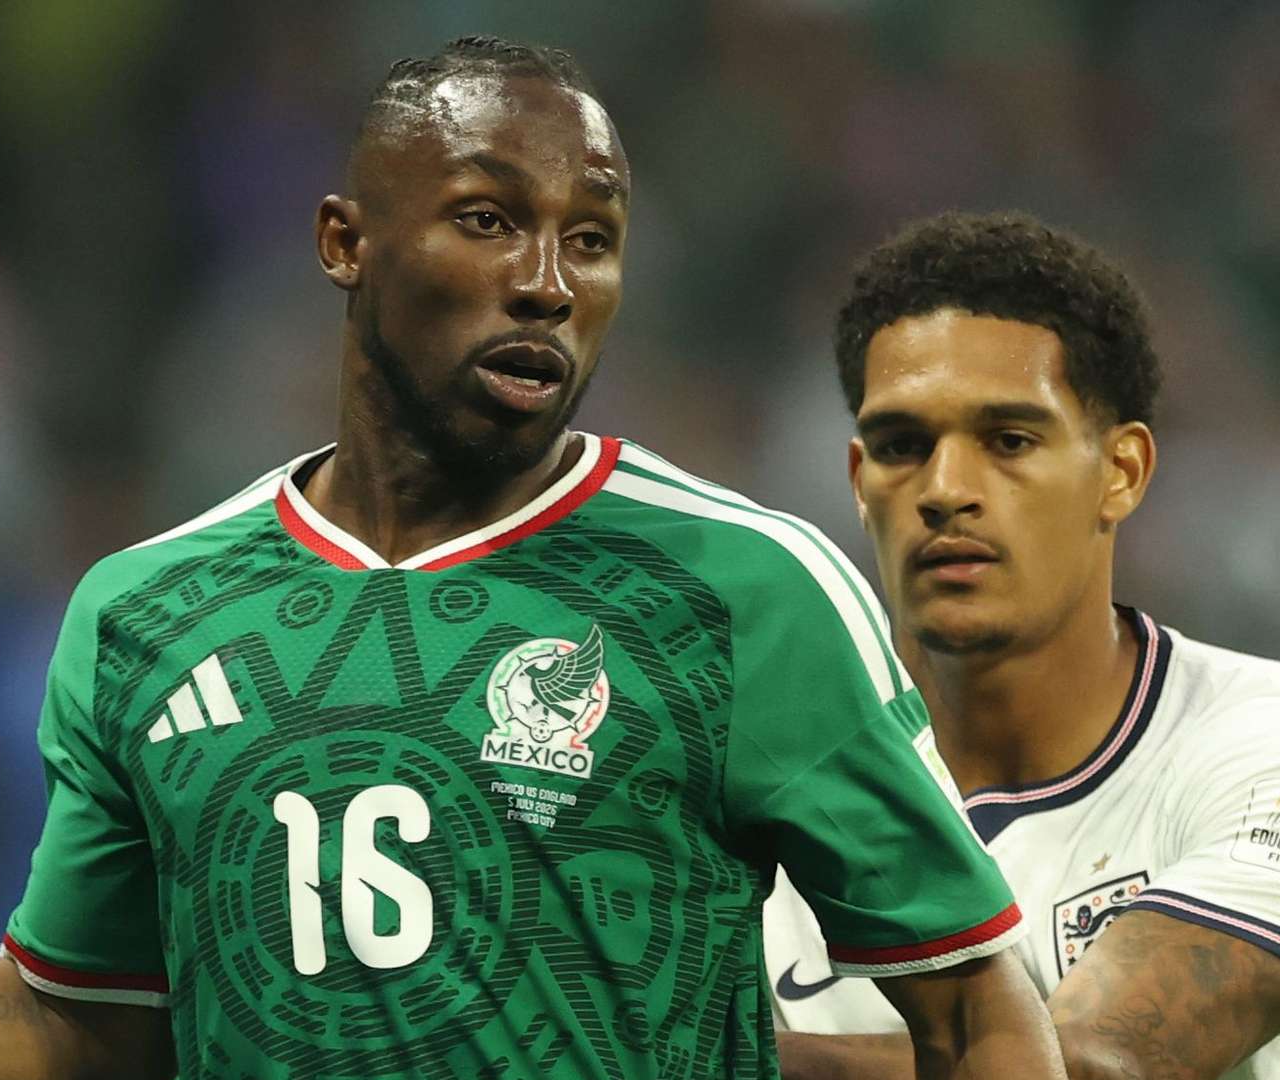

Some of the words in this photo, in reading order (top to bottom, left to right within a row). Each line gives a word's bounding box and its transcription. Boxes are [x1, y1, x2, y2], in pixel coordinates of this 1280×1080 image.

[485, 738, 588, 773] MÉXICO
[515, 798, 534, 810] JULY
[535, 801, 558, 815] 2026
[539, 789, 577, 806] ENGLAND
[273, 784, 433, 975] 16
